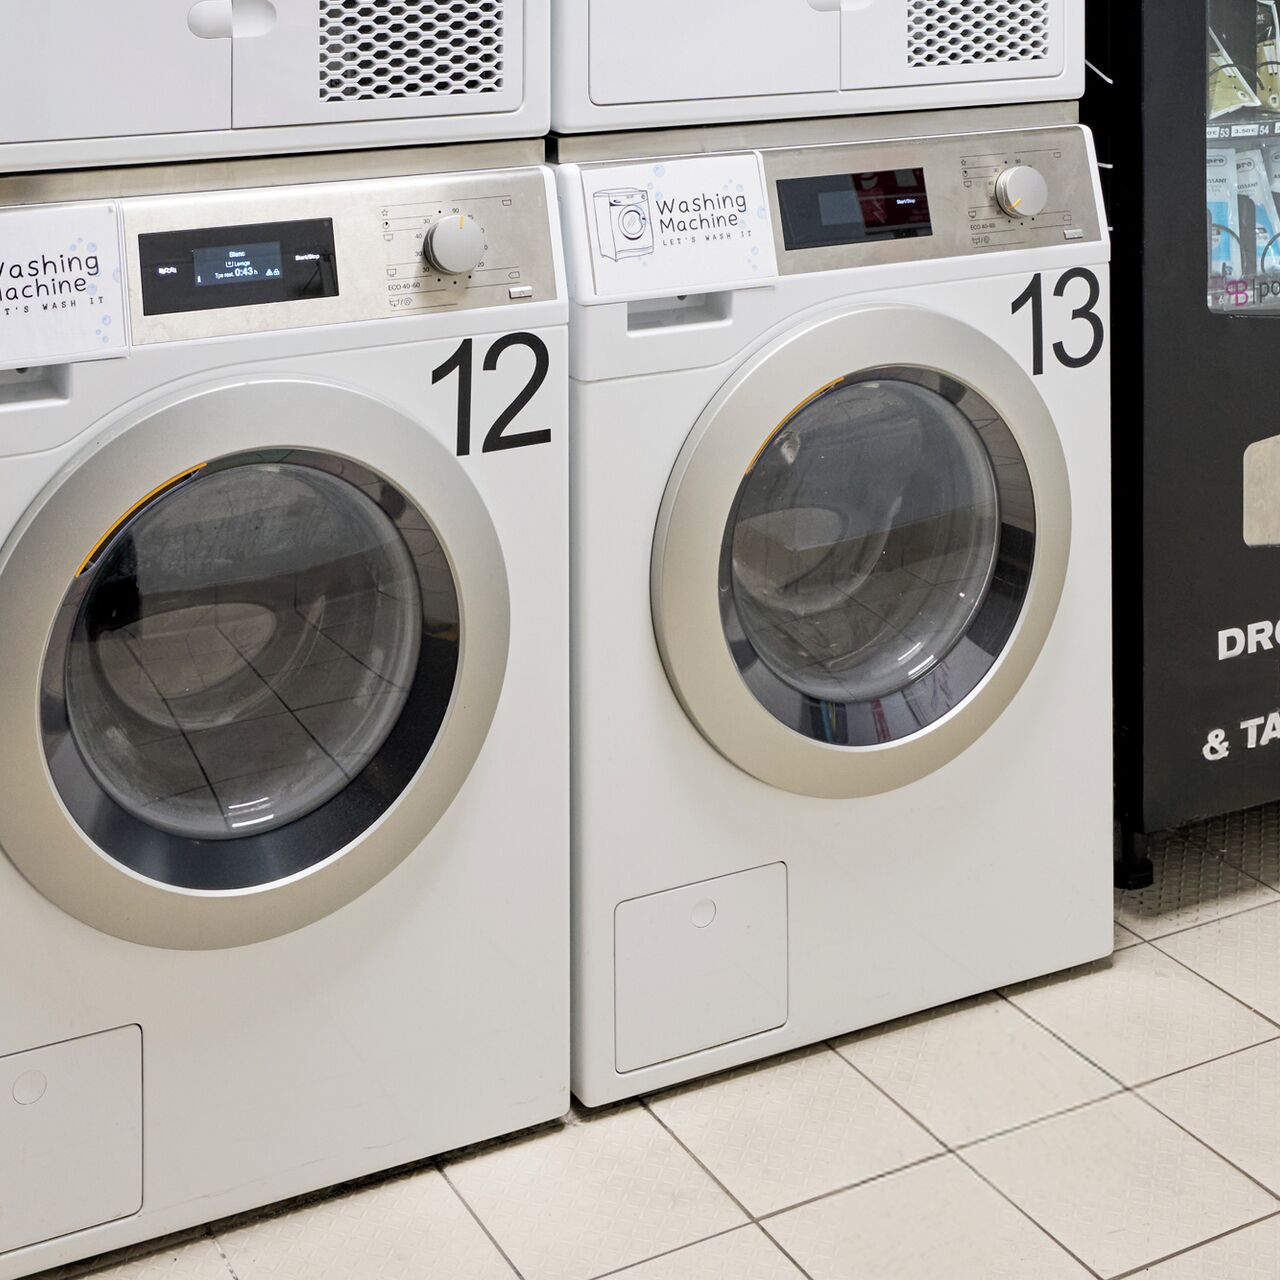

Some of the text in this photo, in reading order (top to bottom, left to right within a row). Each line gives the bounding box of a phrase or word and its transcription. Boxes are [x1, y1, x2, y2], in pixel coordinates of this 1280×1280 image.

[1220, 129, 1230, 137] 53
[1259, 126, 1269, 135] 54
[656, 193, 748, 215] Washing
[660, 213, 738, 233] Machine
[663, 230, 752, 246] LET'S WASH IT
[234, 267, 253, 277] 0:43
[43, 300, 77, 311] WASH
[90, 296, 105, 304] IT
[1011, 267, 1105, 376] 13
[431, 331, 551, 456] 12
[1202, 729, 1230, 761] &
